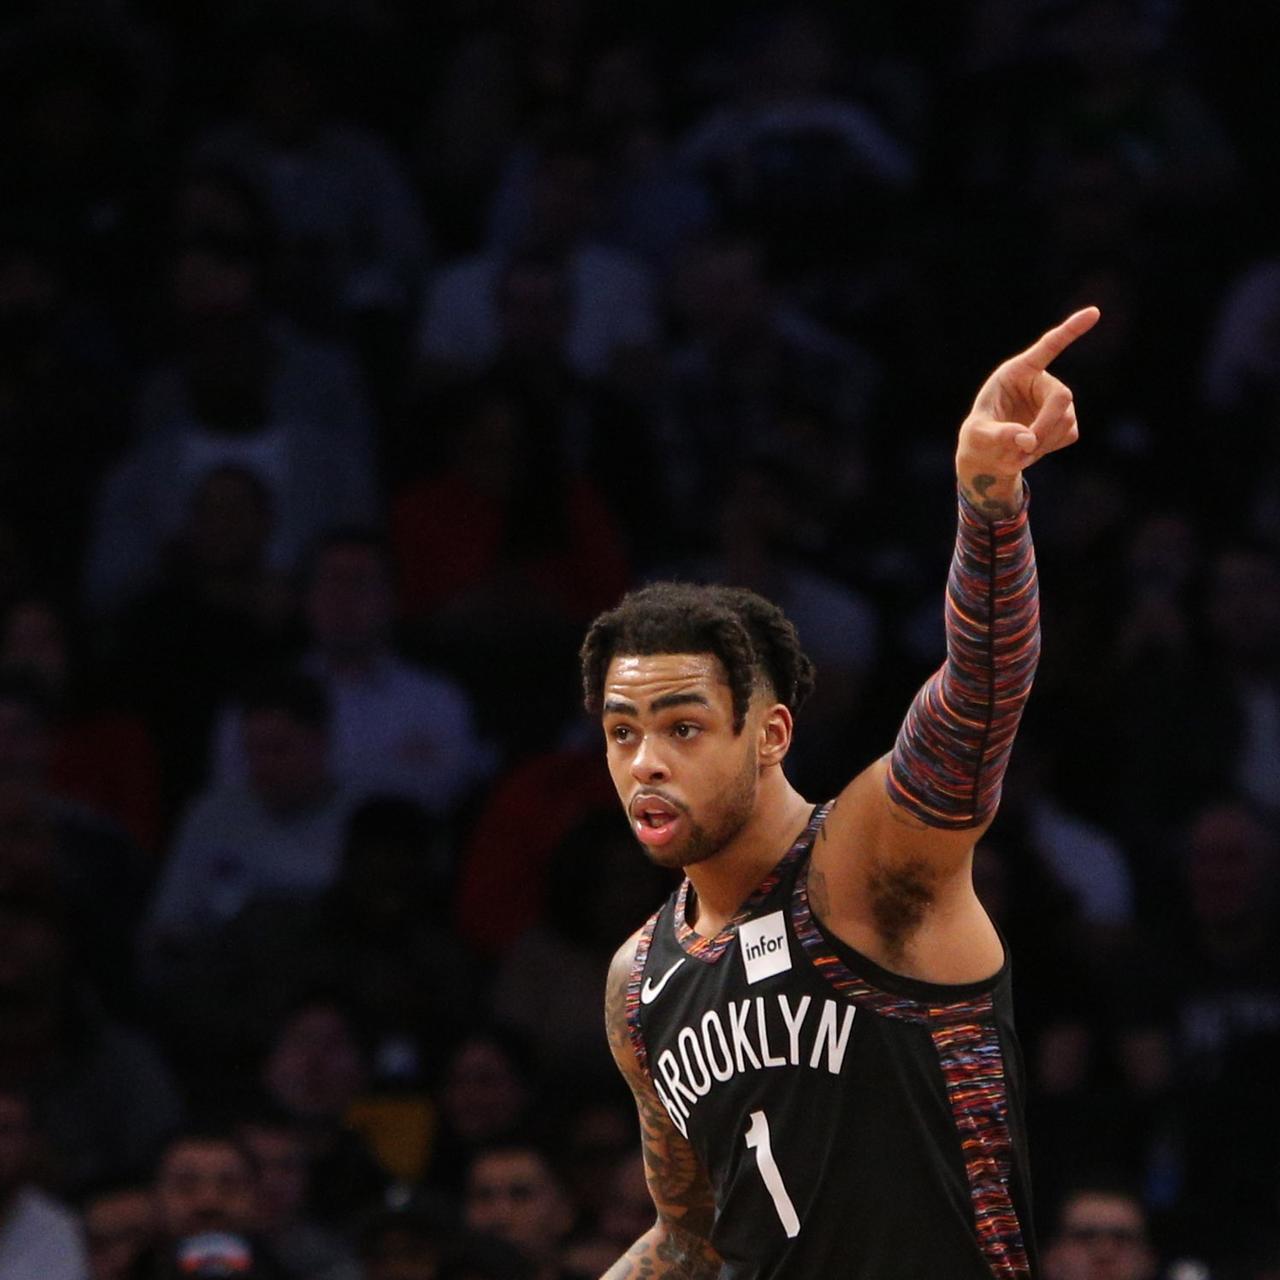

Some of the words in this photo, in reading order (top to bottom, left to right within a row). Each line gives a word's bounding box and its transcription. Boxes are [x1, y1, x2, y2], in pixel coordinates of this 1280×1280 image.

[745, 935, 784, 962] infor
[653, 993, 857, 1140] BROOKLYN
[744, 1110, 801, 1239] 1
